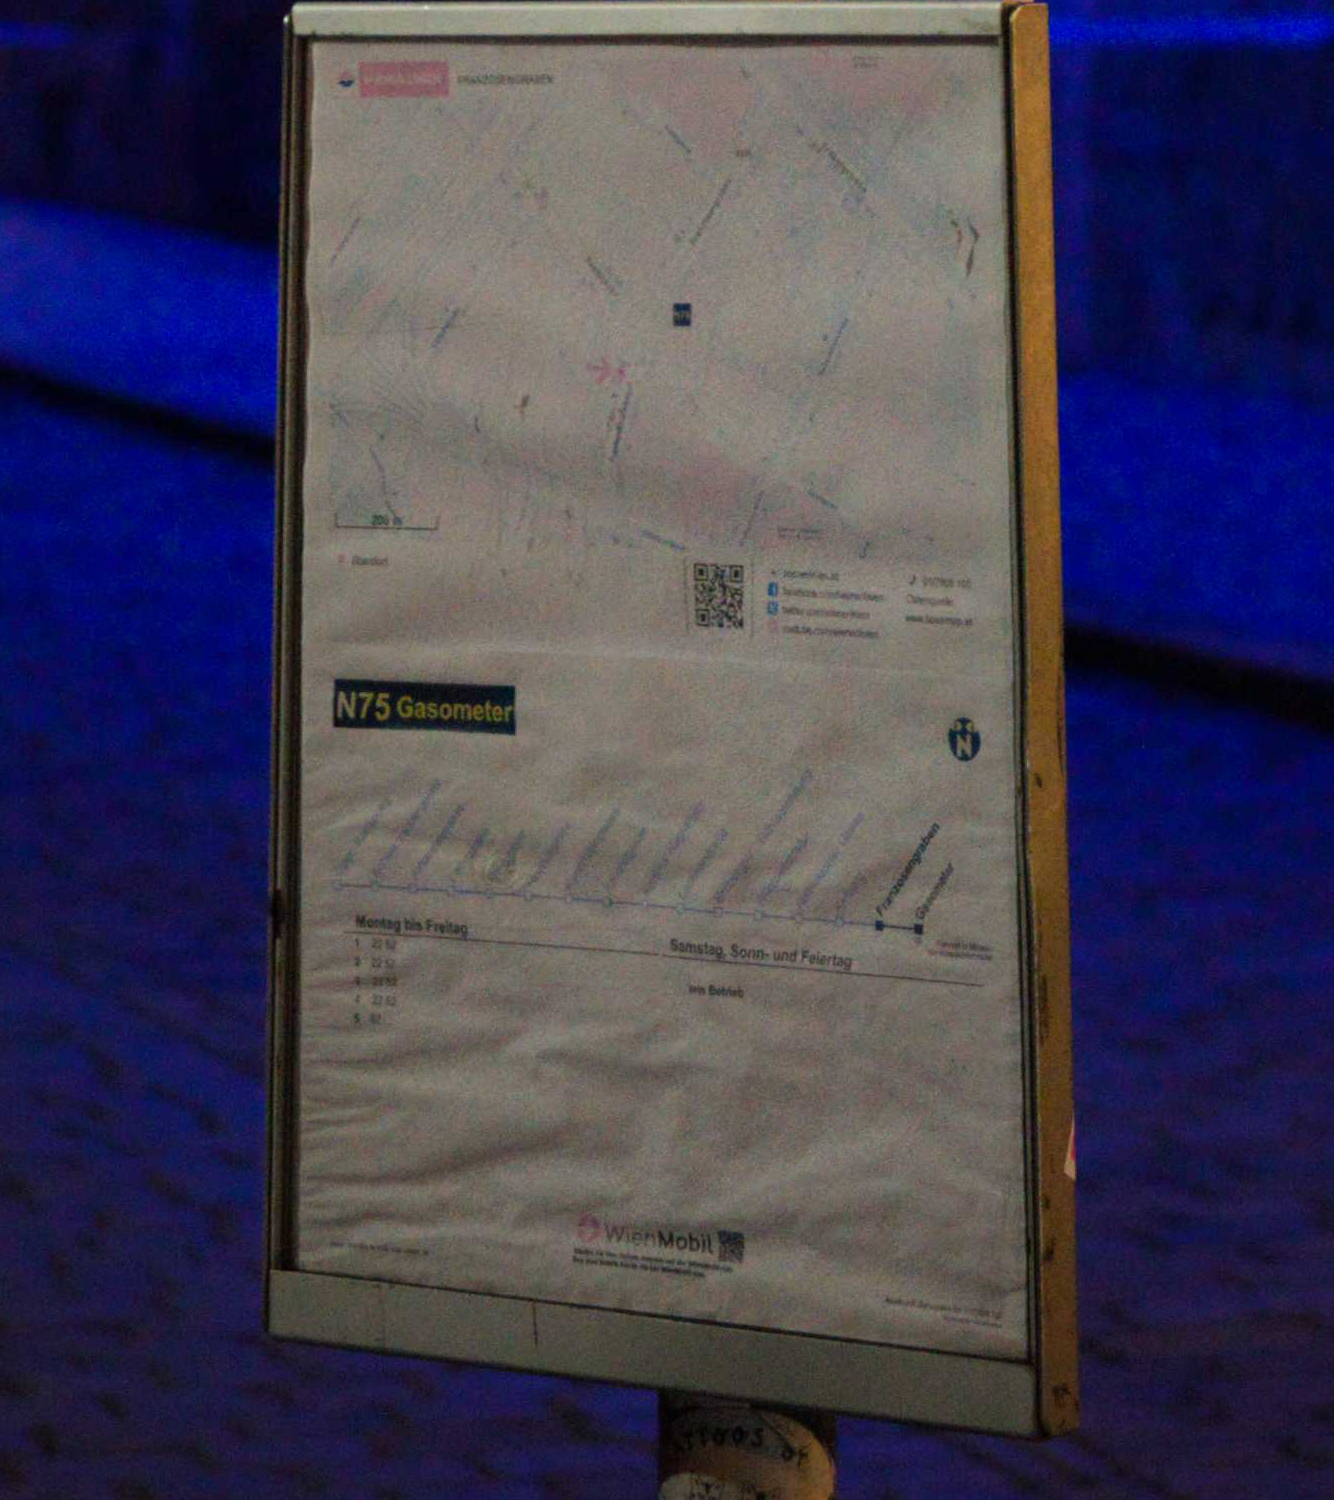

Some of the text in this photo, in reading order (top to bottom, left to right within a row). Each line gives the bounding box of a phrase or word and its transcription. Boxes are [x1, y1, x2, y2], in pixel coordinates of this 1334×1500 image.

[336, 690, 513, 724] N75 Gasometer
[875, 821, 941, 918] Franzosengraben
[355, 914, 469, 940] Montag bis Freitag
[670, 938, 853, 971] Samstag, Sonn- und Feiertag
[604, 1222, 714, 1255] WienMobil
